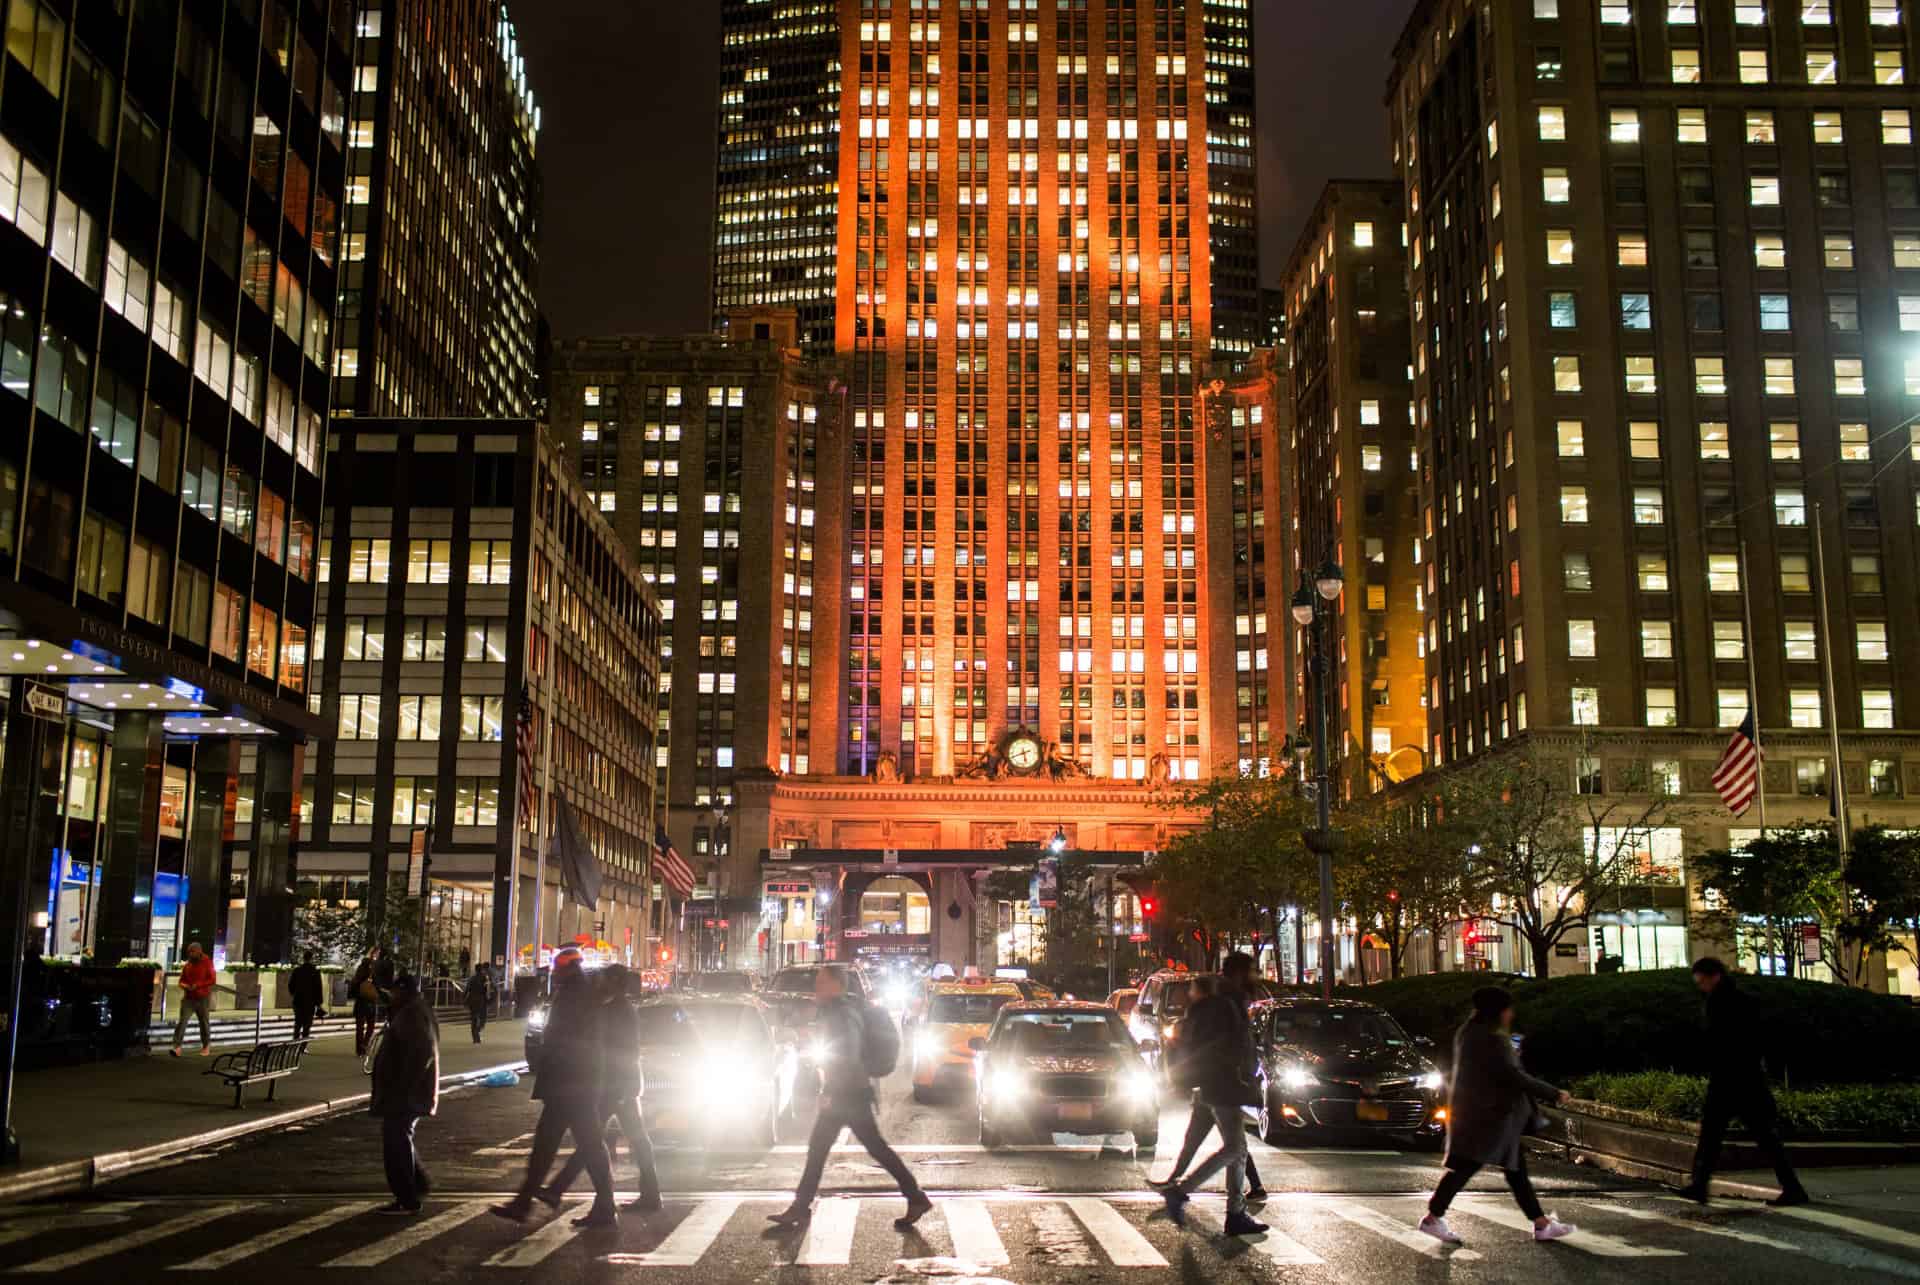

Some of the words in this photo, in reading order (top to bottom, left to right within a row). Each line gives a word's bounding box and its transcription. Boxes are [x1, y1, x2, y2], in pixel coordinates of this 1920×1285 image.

[80, 617, 106, 640] TWO
[31, 691, 45, 706] ONE
[47, 695, 61, 710] WAY
